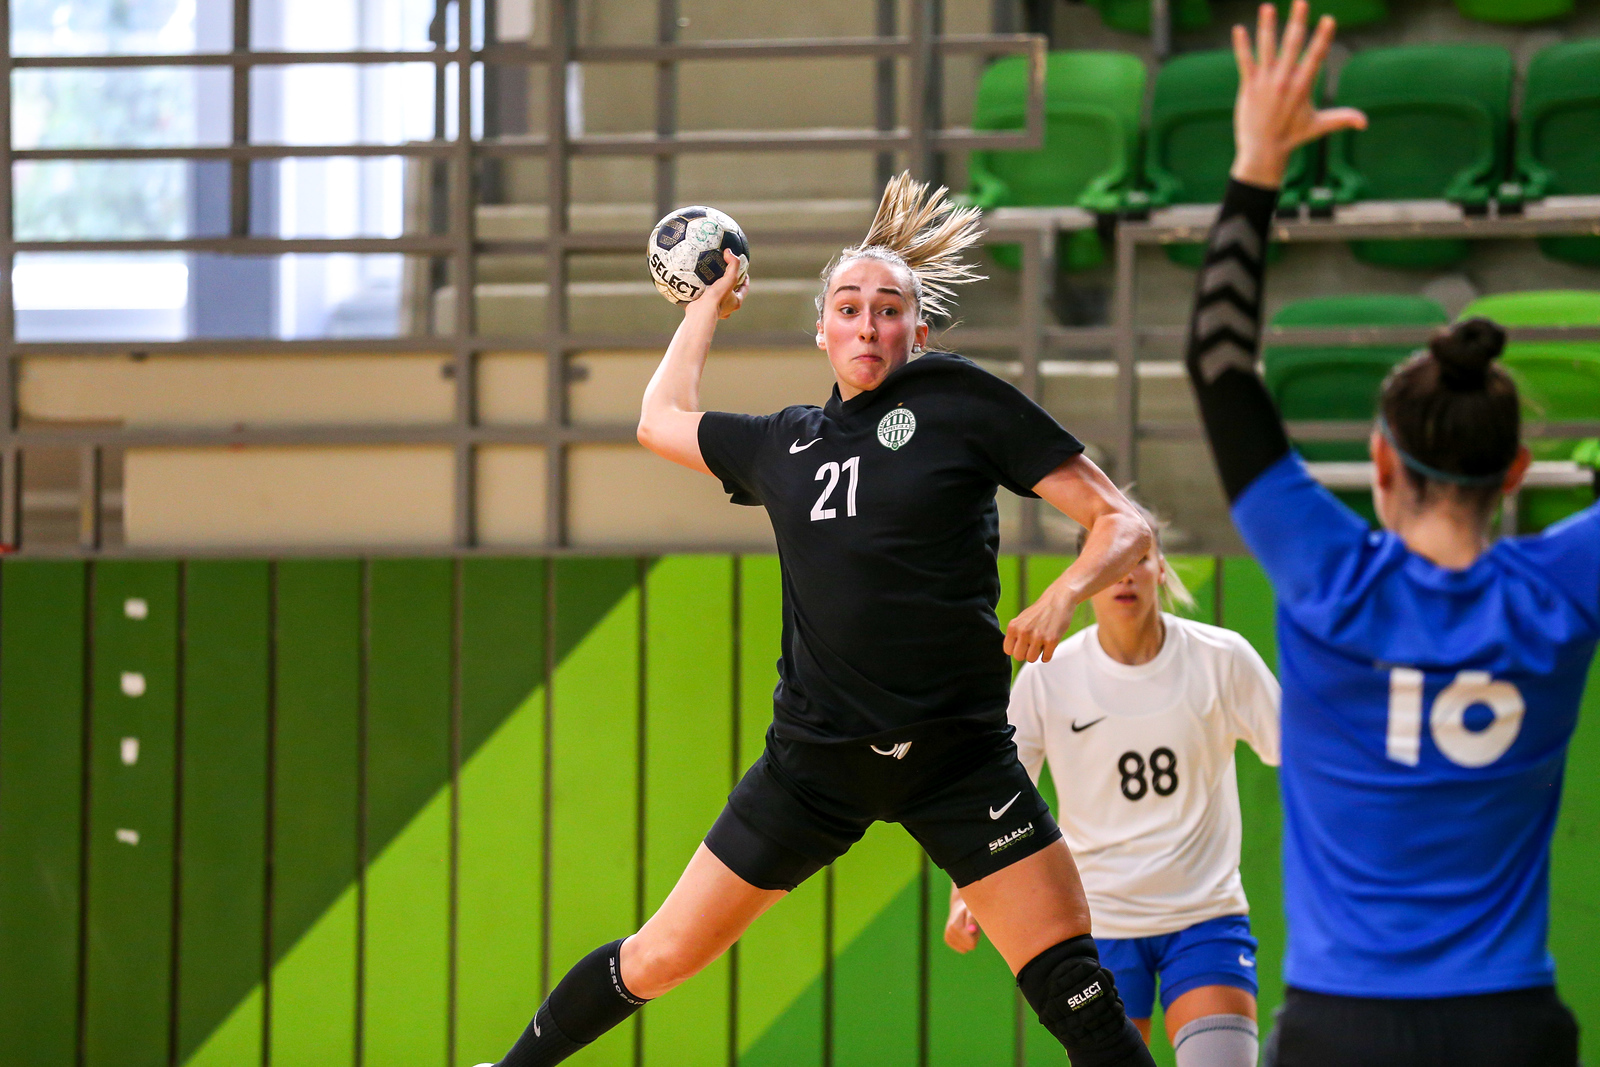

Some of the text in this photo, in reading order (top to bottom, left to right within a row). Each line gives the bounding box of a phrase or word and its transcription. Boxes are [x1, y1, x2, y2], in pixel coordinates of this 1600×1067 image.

[651, 253, 700, 298] SELECT
[810, 455, 860, 521] 21
[1386, 667, 1526, 769] 16
[1118, 746, 1179, 802] 88
[1067, 981, 1102, 1008] SELECT
